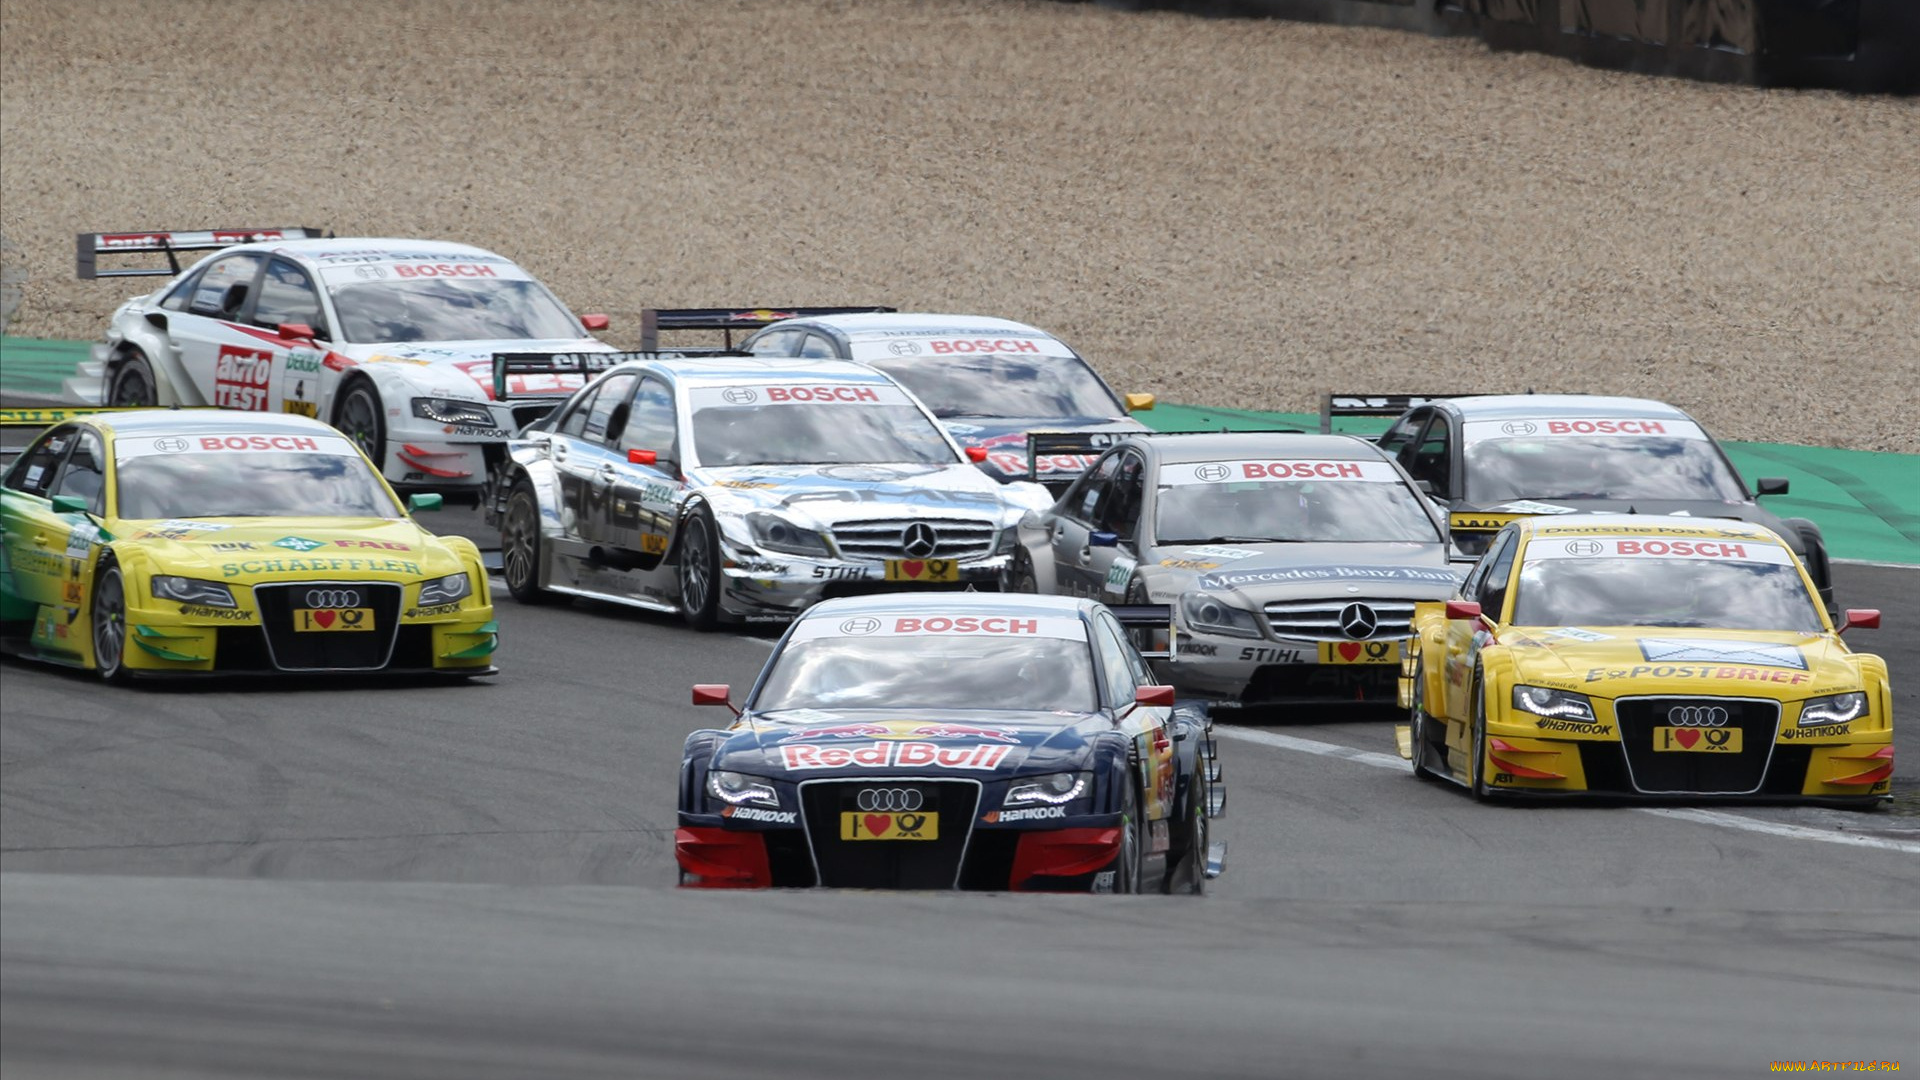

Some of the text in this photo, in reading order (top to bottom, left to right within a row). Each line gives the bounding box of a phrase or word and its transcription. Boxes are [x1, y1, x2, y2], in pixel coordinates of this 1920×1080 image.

[394, 264, 497, 277] BOSCH
[930, 340, 1039, 354] BOSCH
[216, 384, 268, 410] TEST
[766, 385, 879, 402] BOSCH
[1548, 420, 1665, 435] BOSCH
[200, 435, 318, 452] BOSCH
[1242, 462, 1363, 479] BOSCH
[334, 540, 411, 551] FAG
[1617, 541, 1747, 558] BOSCH
[222, 558, 424, 578] SCHAEFFLER
[812, 566, 872, 580] STIHL
[1202, 566, 1400, 588] Mercedes-Benz
[894, 617, 1037, 634] BOSCH
[1239, 647, 1305, 663] STIHL
[1547, 720, 1613, 736] Hankook
[1795, 724, 1850, 739] Hankook
[781, 742, 1012, 770] Red Bull
[732, 806, 797, 824] Hankook
[999, 806, 1065, 822] Hankook
